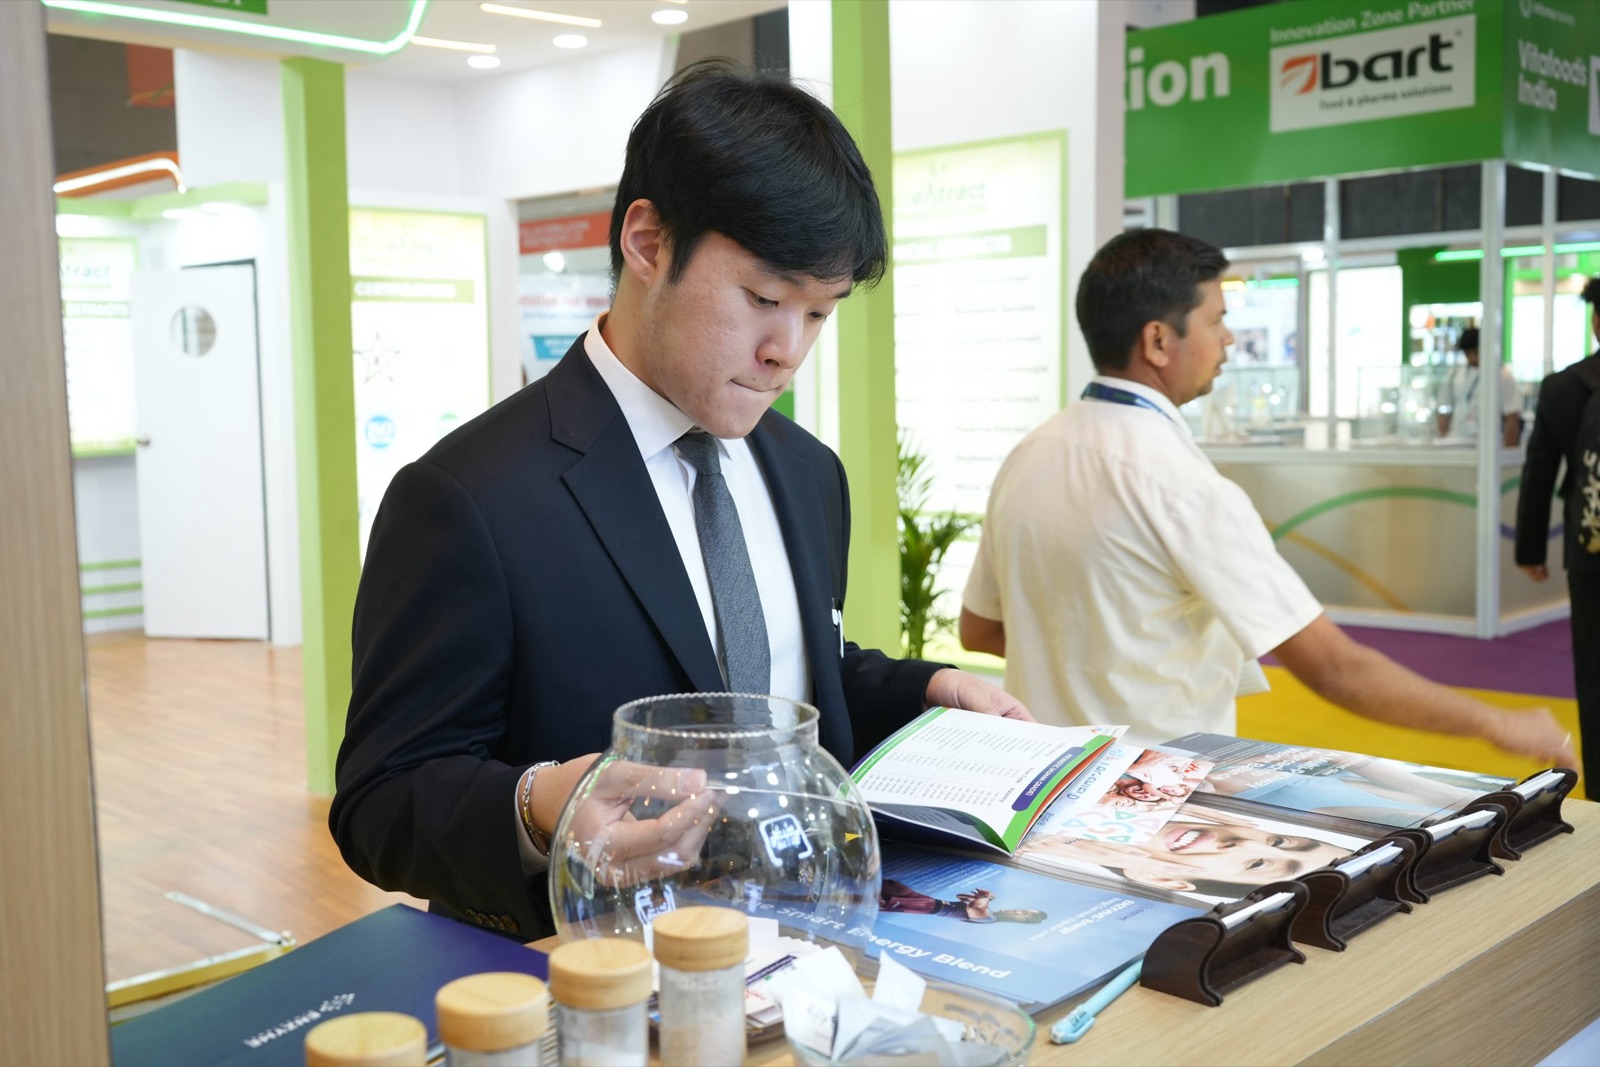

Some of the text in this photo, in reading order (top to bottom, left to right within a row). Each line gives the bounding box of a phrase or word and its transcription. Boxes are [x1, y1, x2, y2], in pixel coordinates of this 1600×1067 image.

[1270, 16, 1356, 43] Innovation
[1360, 7, 1404, 28] Zone
[1126, 46, 1230, 111] ion
[1321, 33, 1453, 90] bart
[1401, 84, 1453, 101] solutions
[1518, 72, 1557, 111] India
[777, 905, 847, 931] Smart
[848, 926, 934, 959] Energy
[932, 953, 1012, 981] Blend
